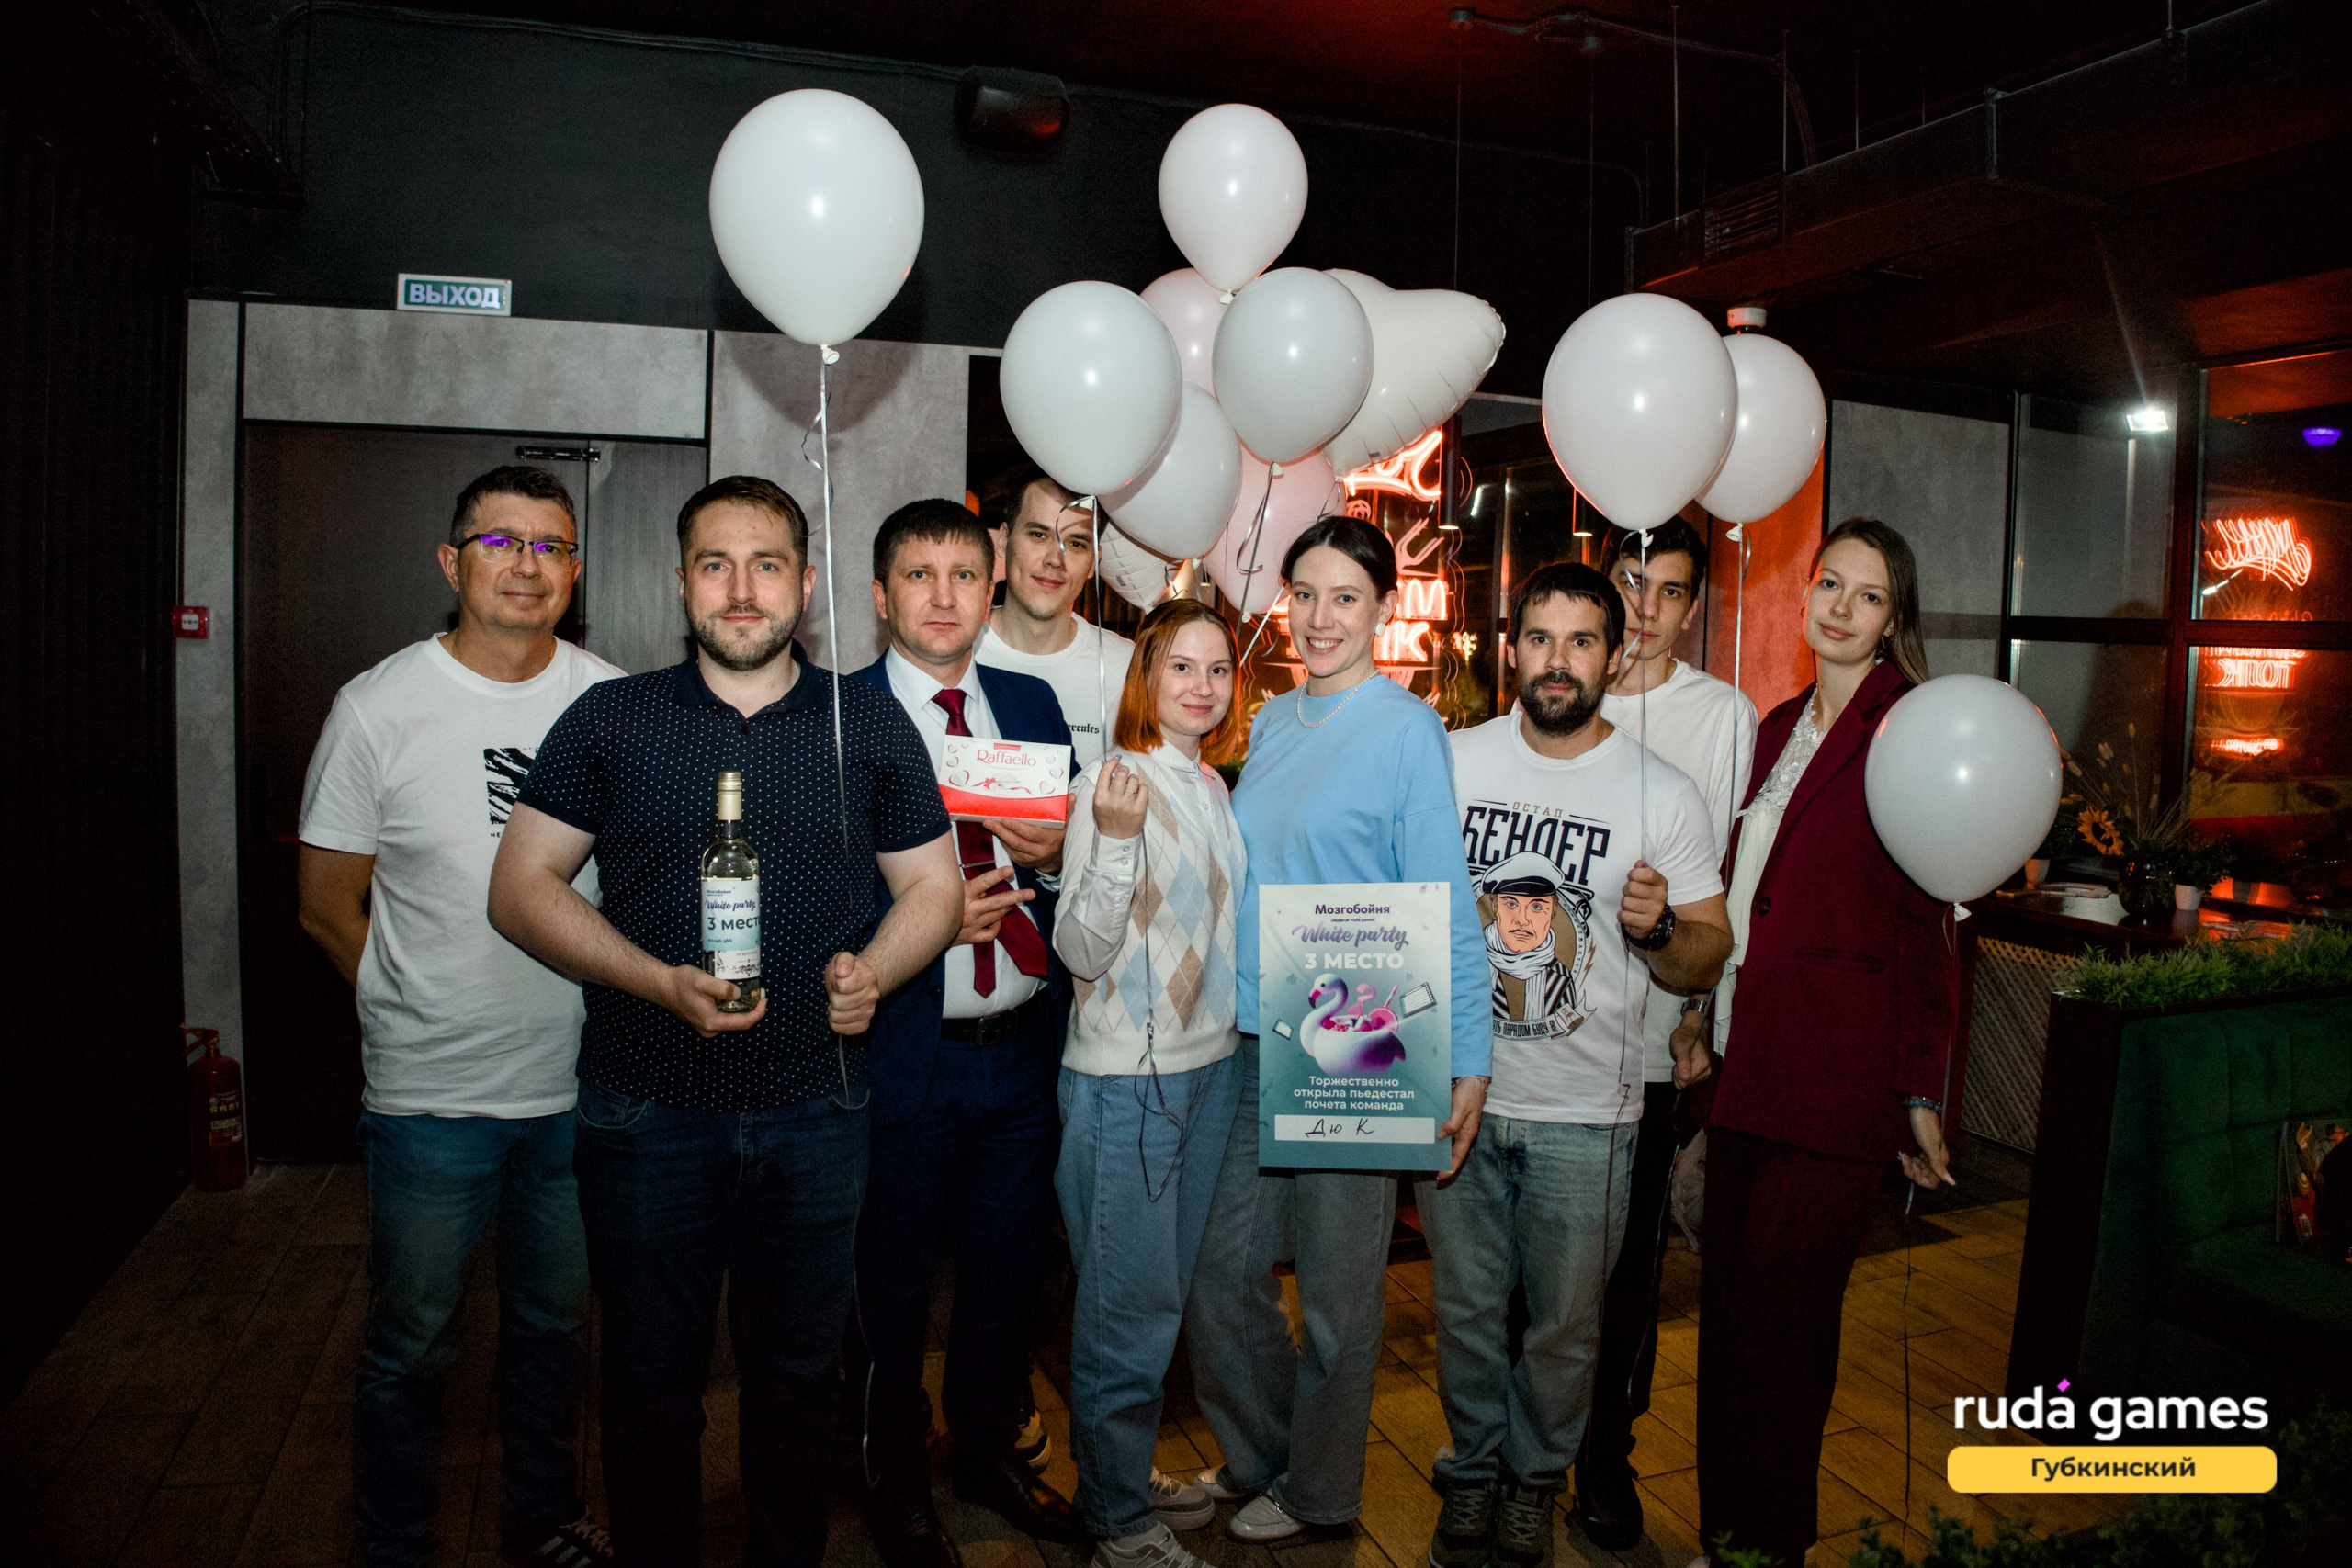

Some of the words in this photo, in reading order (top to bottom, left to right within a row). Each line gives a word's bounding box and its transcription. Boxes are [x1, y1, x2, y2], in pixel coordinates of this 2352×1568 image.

[409, 283, 500, 309] ВЫХОД
[977, 749, 1036, 767] Raffaello
[1512, 801, 1564, 818] ОСТАП
[1463, 805, 1611, 886] БЕНДЕР
[705, 900, 732, 910] White
[732, 899, 756, 911] party
[1315, 903, 1390, 915] Мозгобойня
[707, 917, 716, 931] 3
[1291, 921, 1353, 943] White
[1353, 925, 1409, 951] party
[1305, 953, 1317, 970] 3
[1324, 953, 1405, 970] МЕСТО
[1502, 1022, 1531, 1038] ПАРАДОМ
[1532, 1021, 1549, 1036] БУДУ
[1308, 1076, 1399, 1088] Торжественно
[1294, 1089, 1346, 1099] открыла
[1350, 1089, 1415, 1099] пьедестал
[1305, 1100, 1346, 1109] почета
[1351, 1101, 1404, 1111] команда
